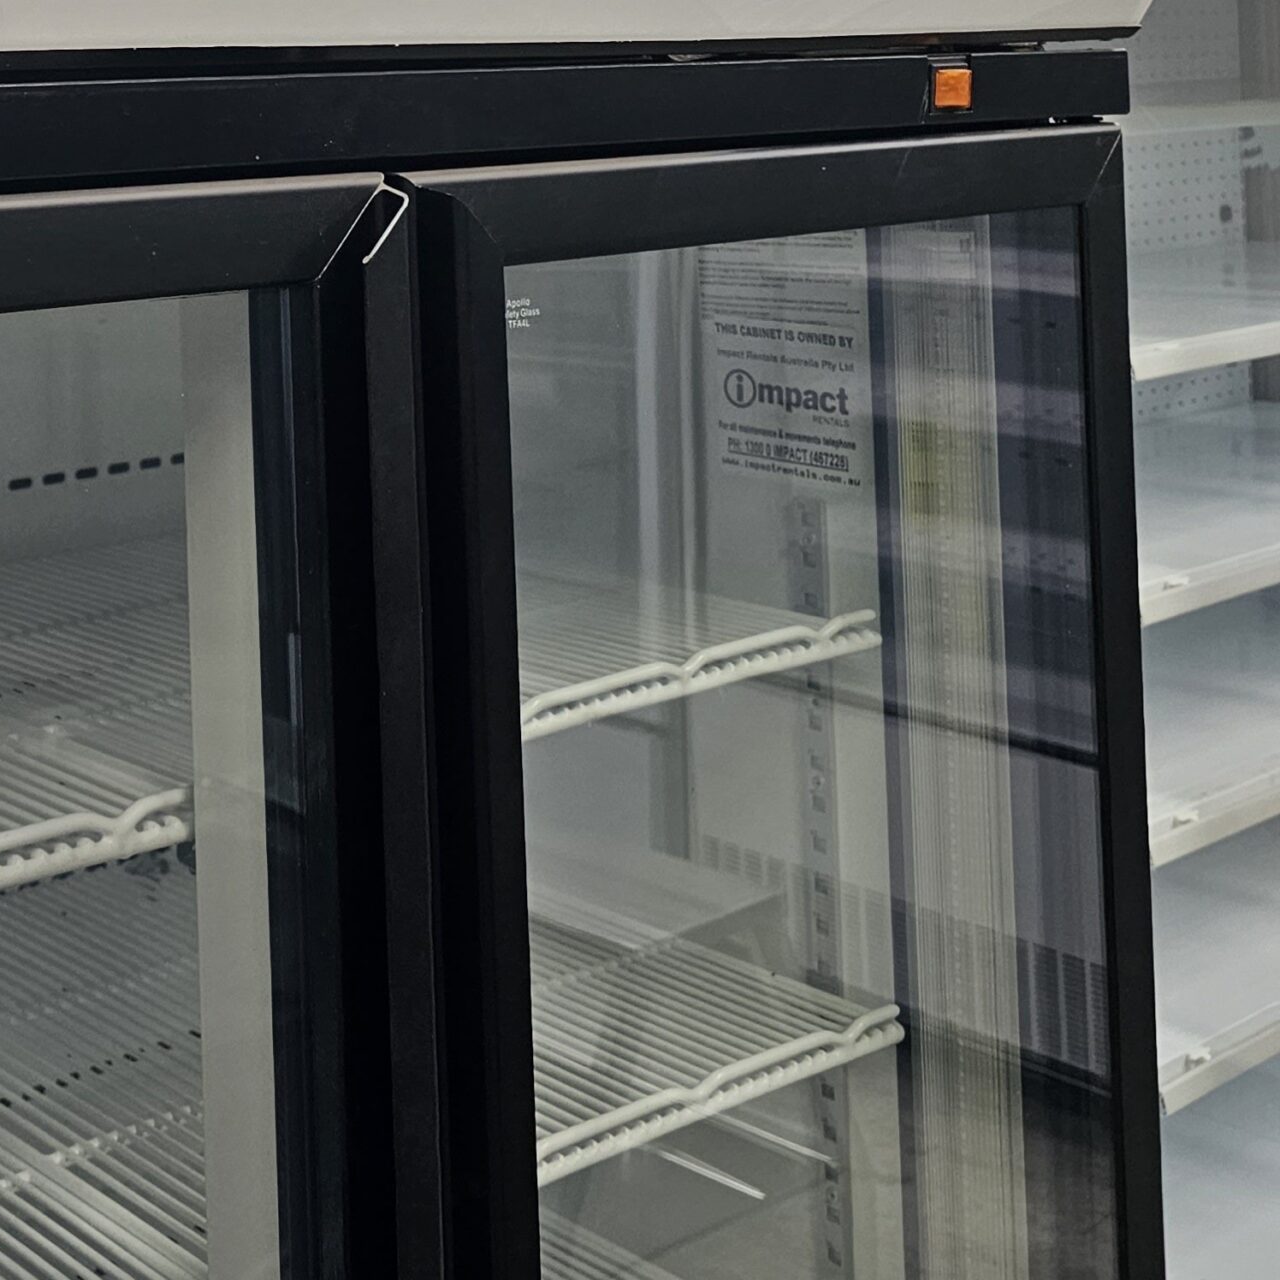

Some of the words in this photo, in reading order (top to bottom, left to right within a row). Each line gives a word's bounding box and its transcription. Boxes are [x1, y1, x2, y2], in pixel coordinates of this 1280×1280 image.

[506, 299, 530, 308] Apollo
[715, 322, 737, 335] THIS
[739, 325, 782, 340] CABINET
[785, 330, 795, 342] IS
[797, 331, 836, 347] OWNED
[838, 336, 854, 349] BY
[821, 360, 836, 372] Pty
[838, 361, 855, 372] Ltd
[724, 369, 849, 415] impact
[773, 444, 808, 462] IMPACT
